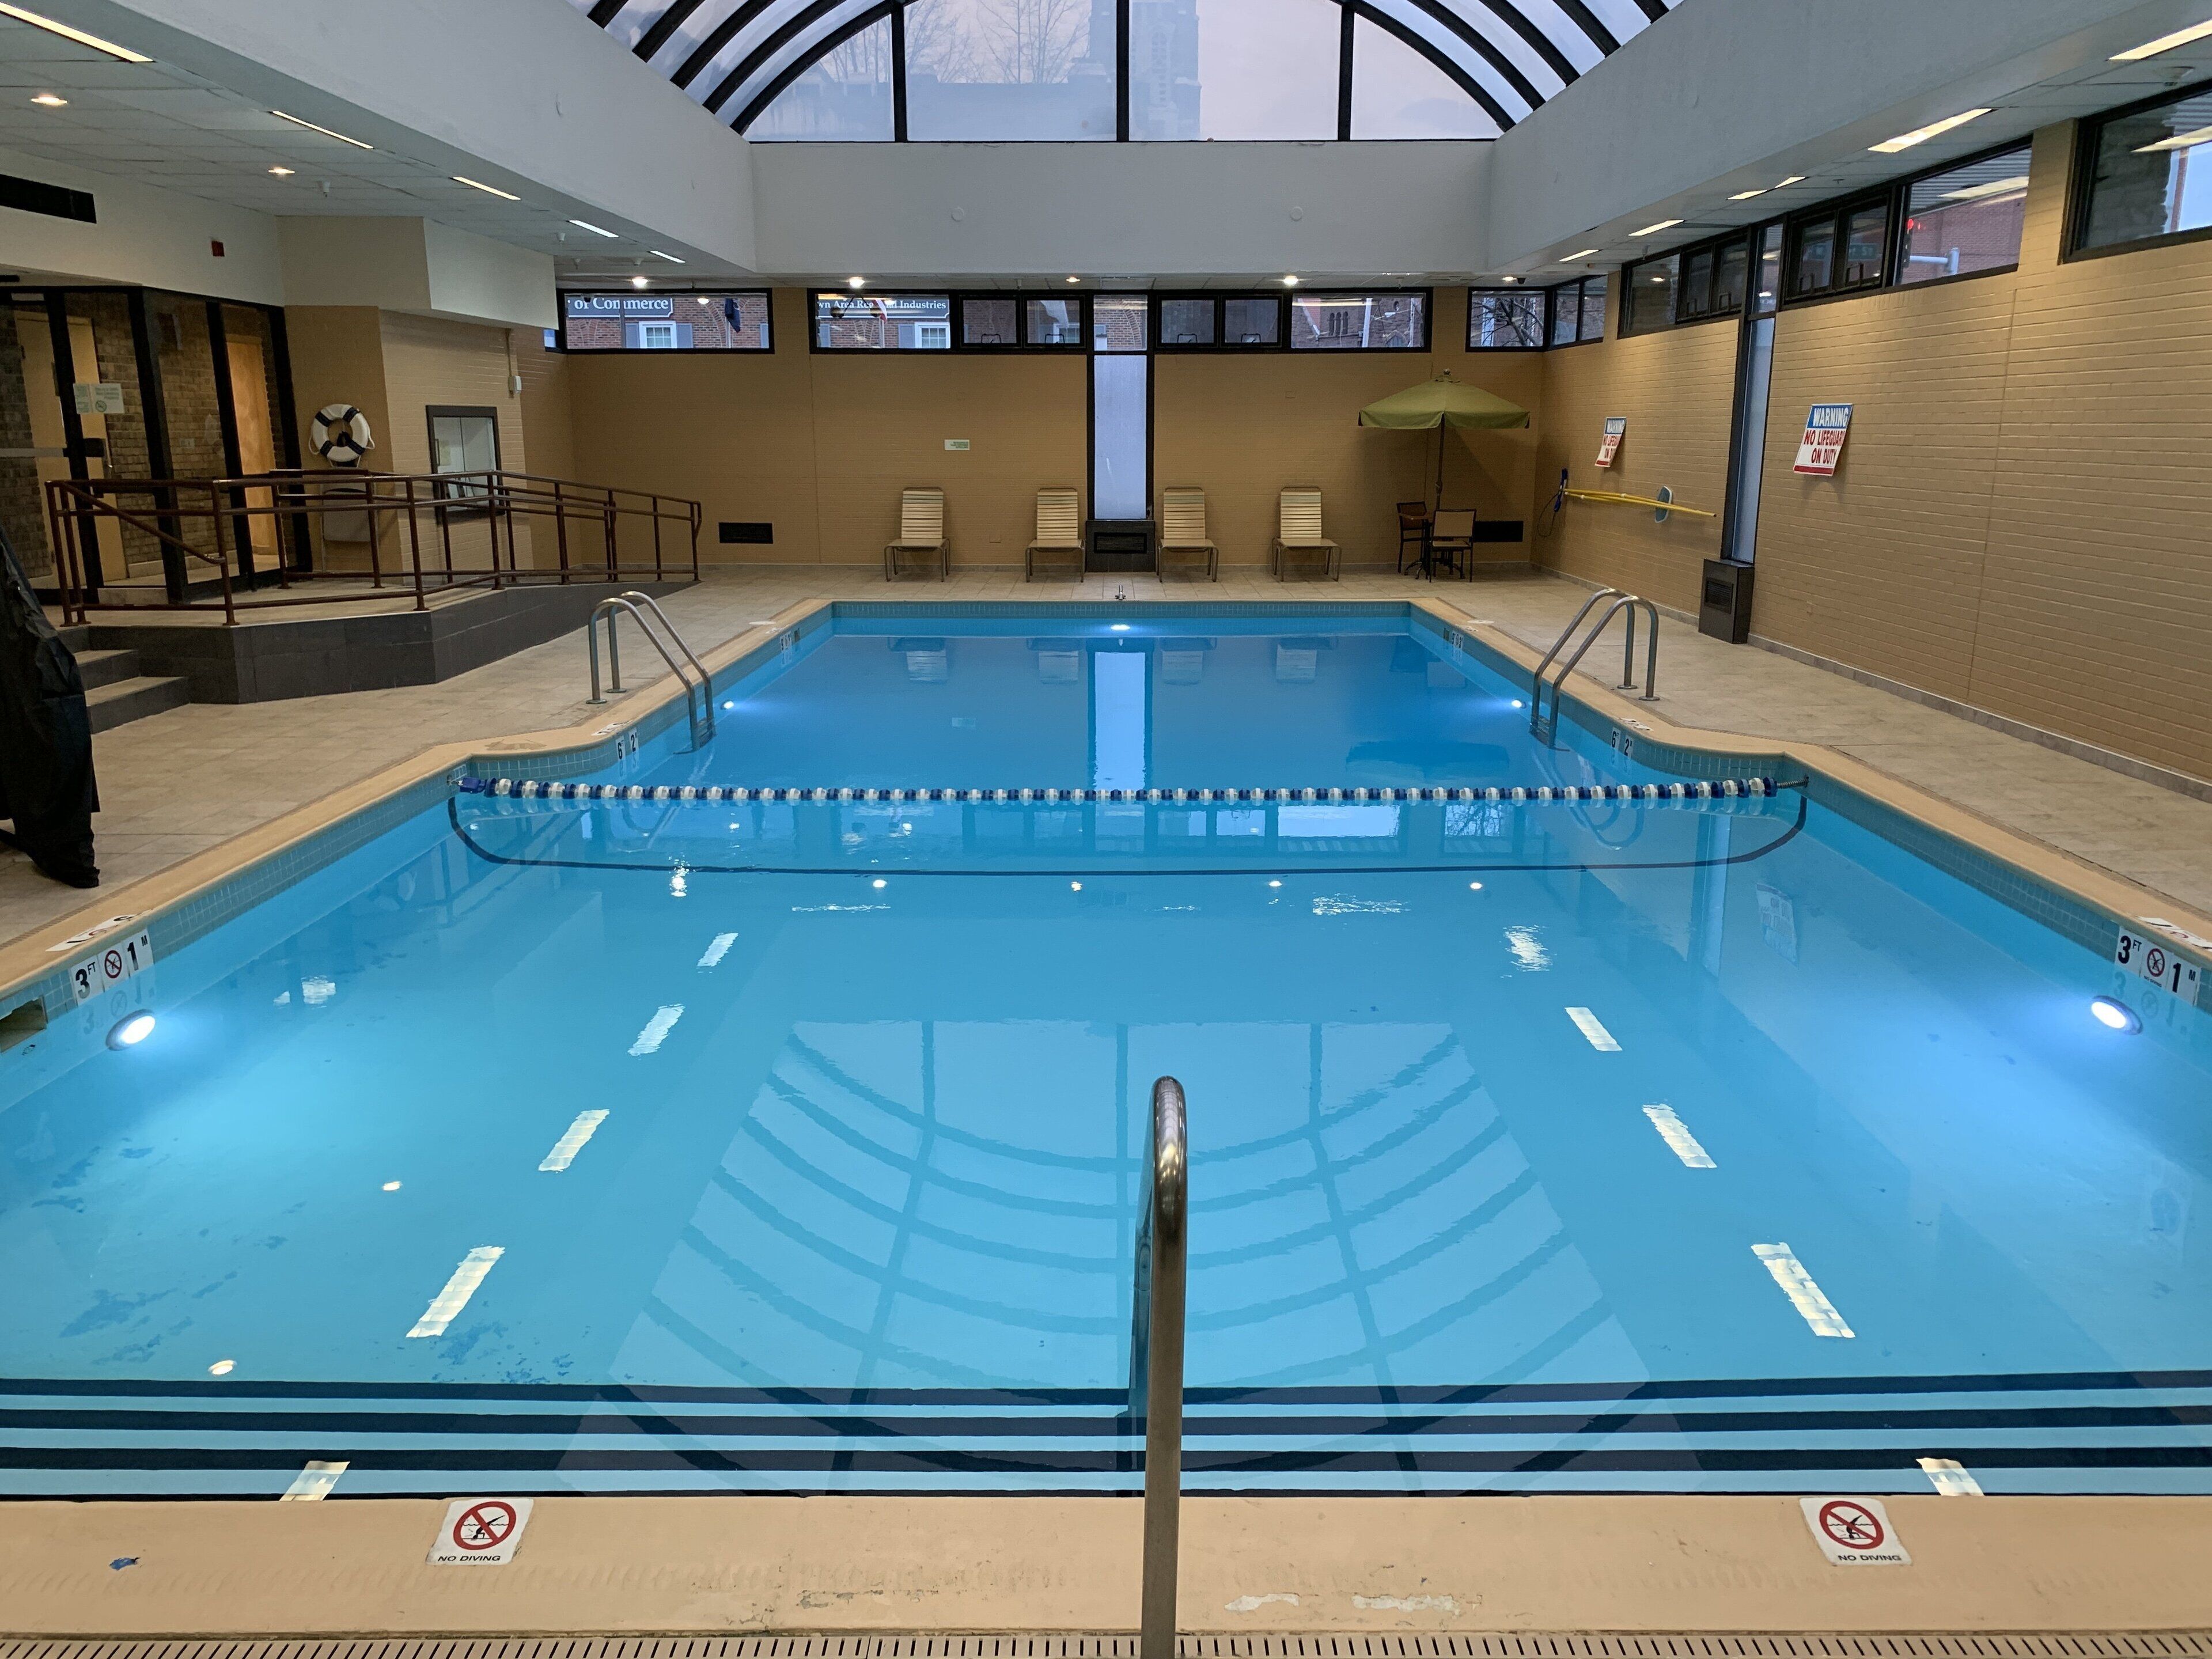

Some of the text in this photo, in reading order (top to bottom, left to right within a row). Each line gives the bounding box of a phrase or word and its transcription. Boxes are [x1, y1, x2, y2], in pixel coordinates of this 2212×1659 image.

[900, 300, 946, 309] Industries
[1813, 407, 1849, 427] WARNING
[1804, 430, 1816, 445] NO
[1811, 448, 1838, 464] ON DUTY
[618, 734, 636, 760] 6 2
[1612, 731, 1629, 756] 6 2
[75, 968, 90, 999] 3
[87, 961, 96, 975] FT
[127, 942, 139, 971] 1
[2118, 935, 2196, 993] 3 FT 1 M
